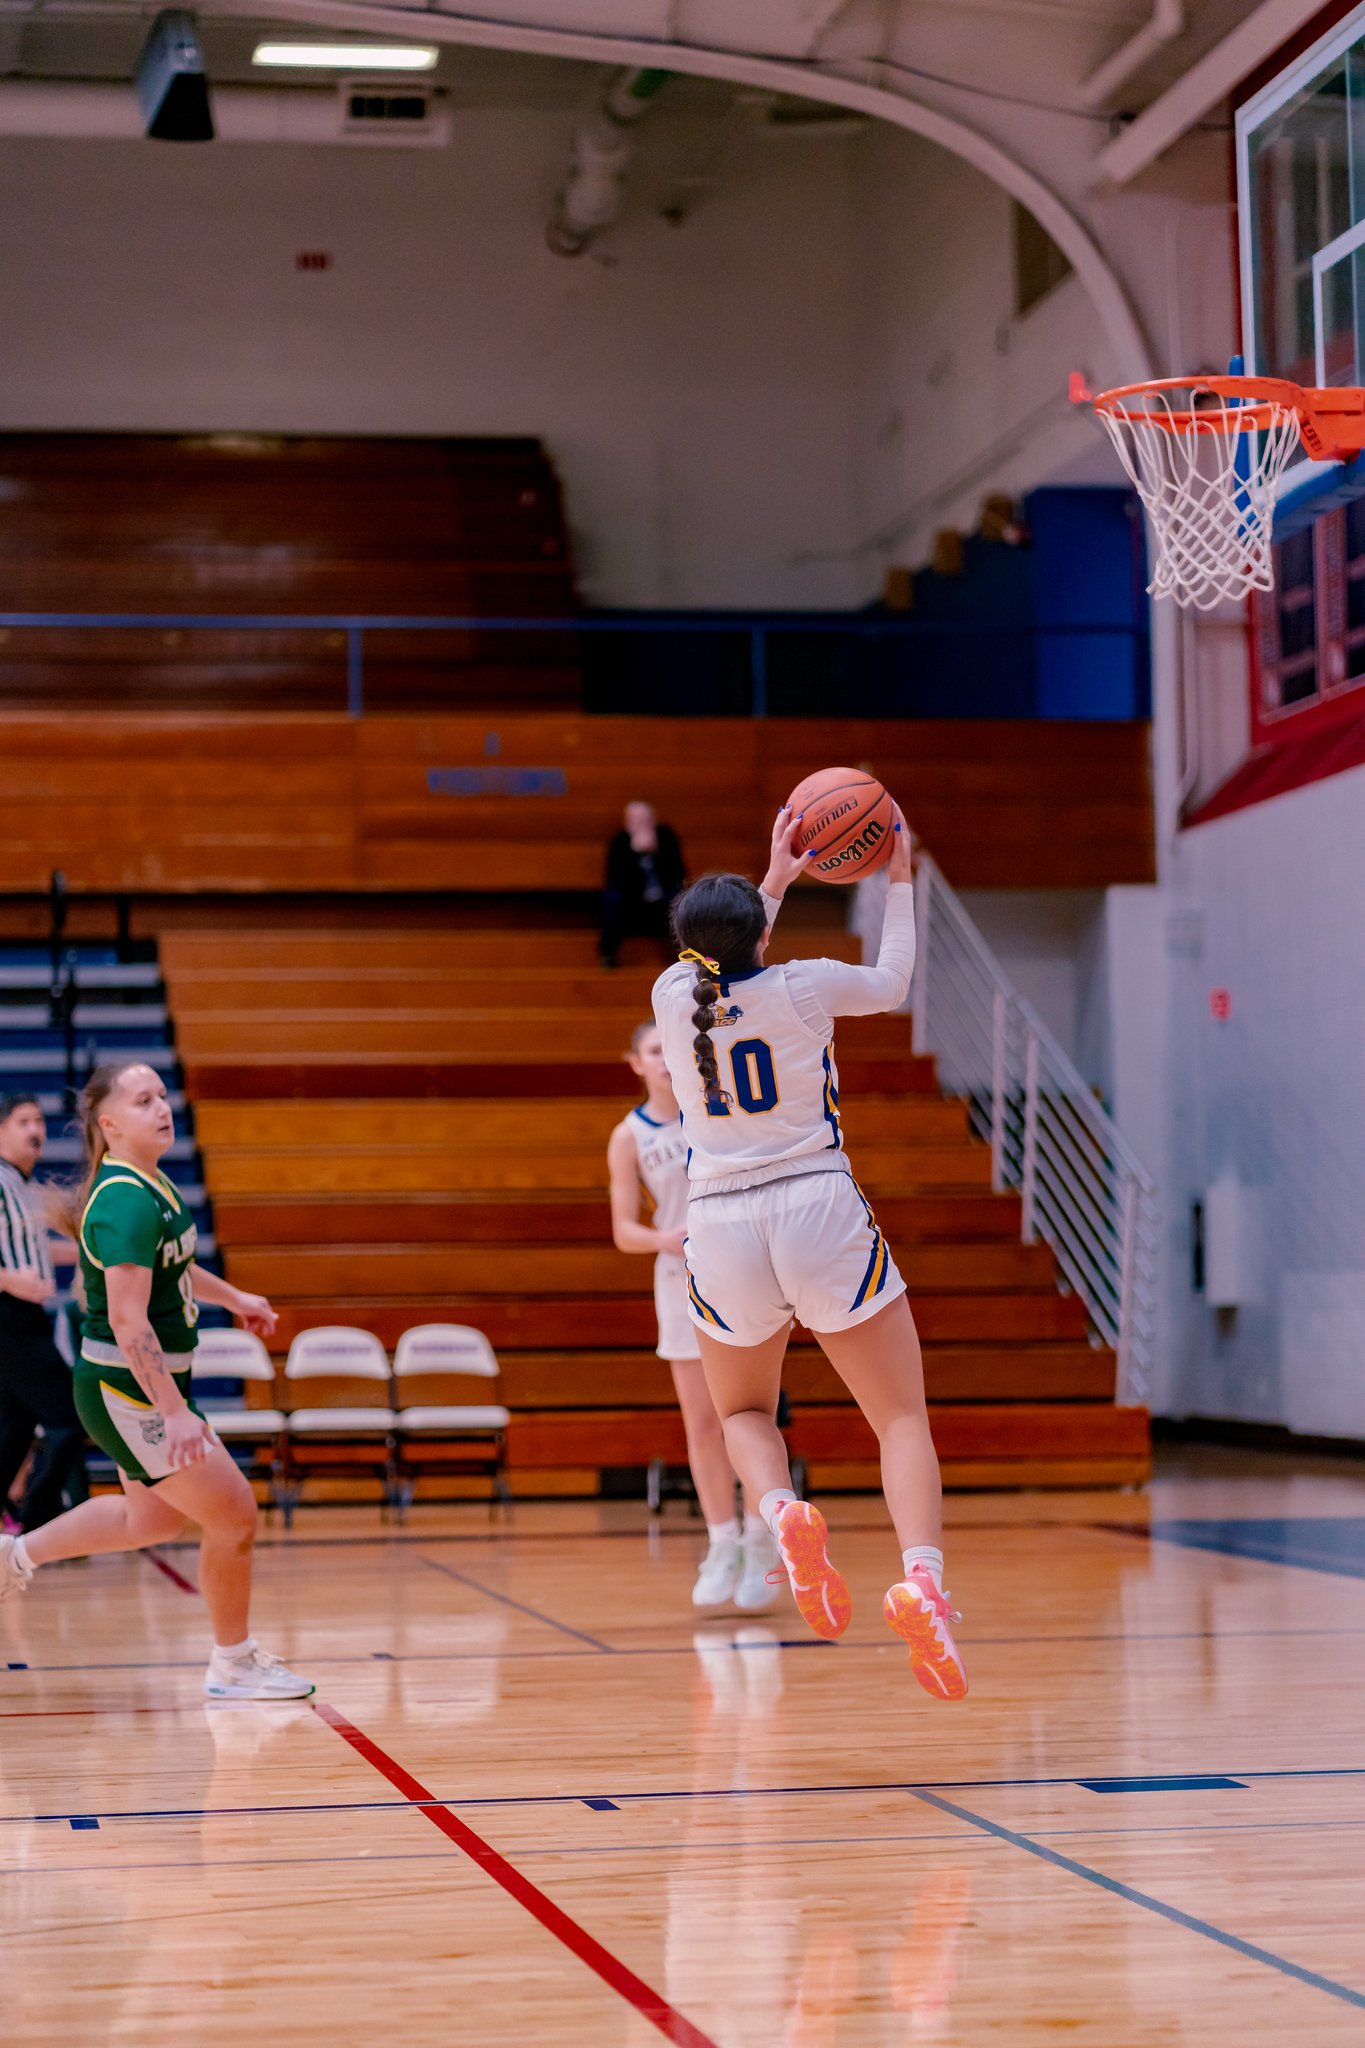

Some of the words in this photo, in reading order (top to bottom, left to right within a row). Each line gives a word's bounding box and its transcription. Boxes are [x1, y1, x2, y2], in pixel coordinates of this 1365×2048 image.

[800, 799, 859, 848] EVOLUTION
[816, 819, 886, 873] Wilson
[692, 1036, 781, 1118] 10
